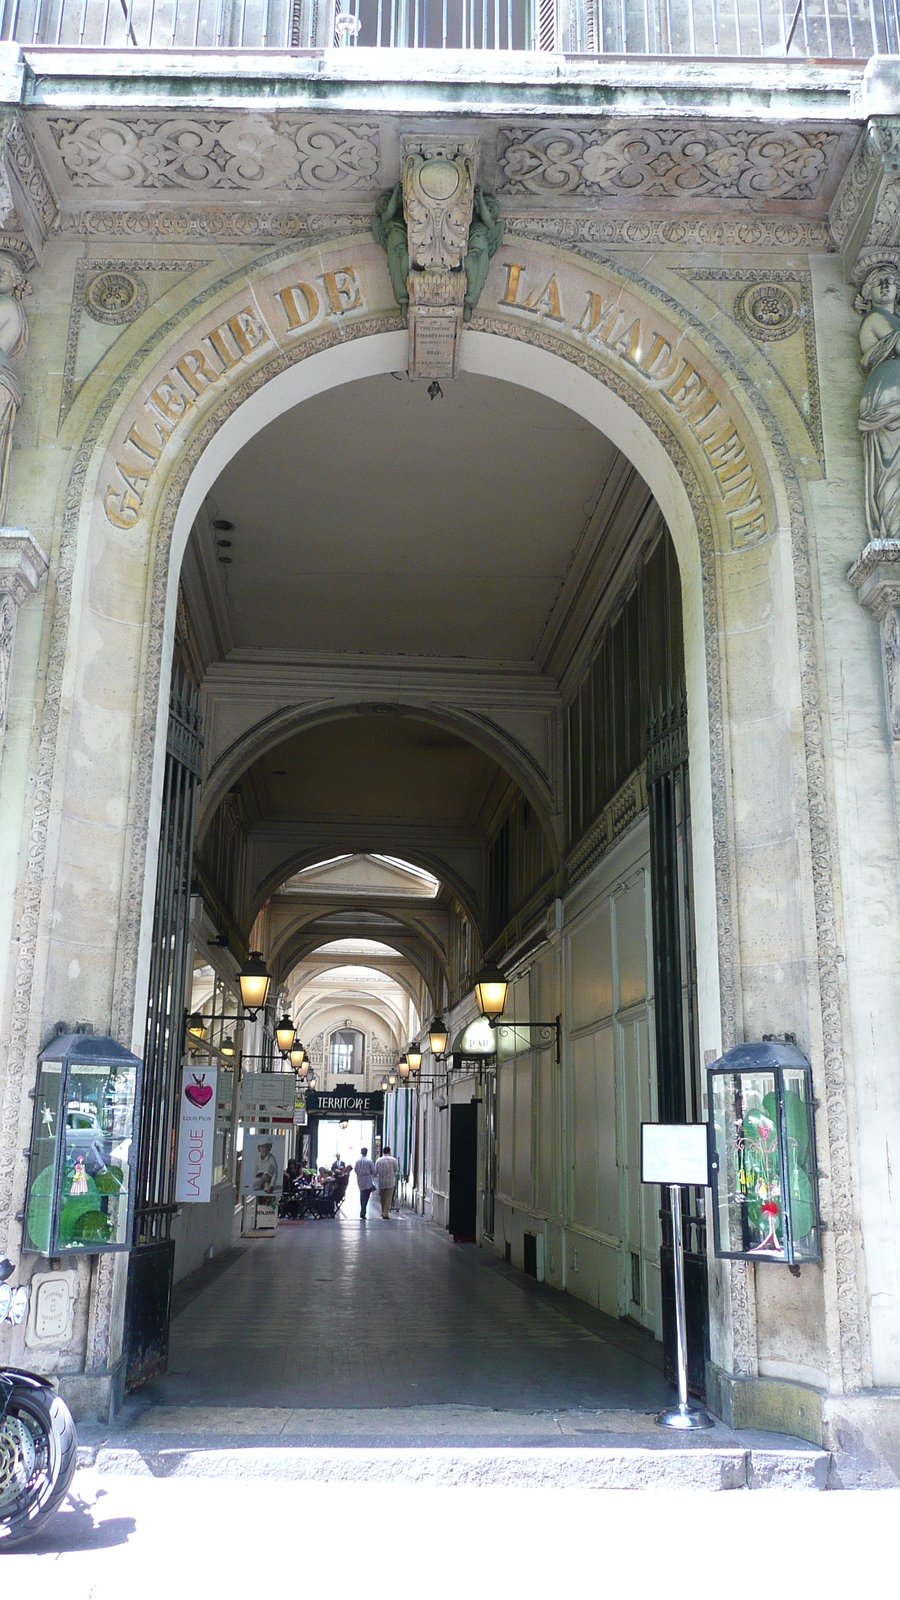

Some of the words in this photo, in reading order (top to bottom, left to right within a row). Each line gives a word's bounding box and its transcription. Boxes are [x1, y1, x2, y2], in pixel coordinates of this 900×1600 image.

[104, 306, 272, 530] GALERIE
[274, 266, 363, 333] DE
[498, 262, 566, 323] LA
[572, 289, 773, 551] MADELEINE
[317, 1096, 371, 1111] TERRITOIRE
[186, 1129, 204, 1197] LALIQUE
